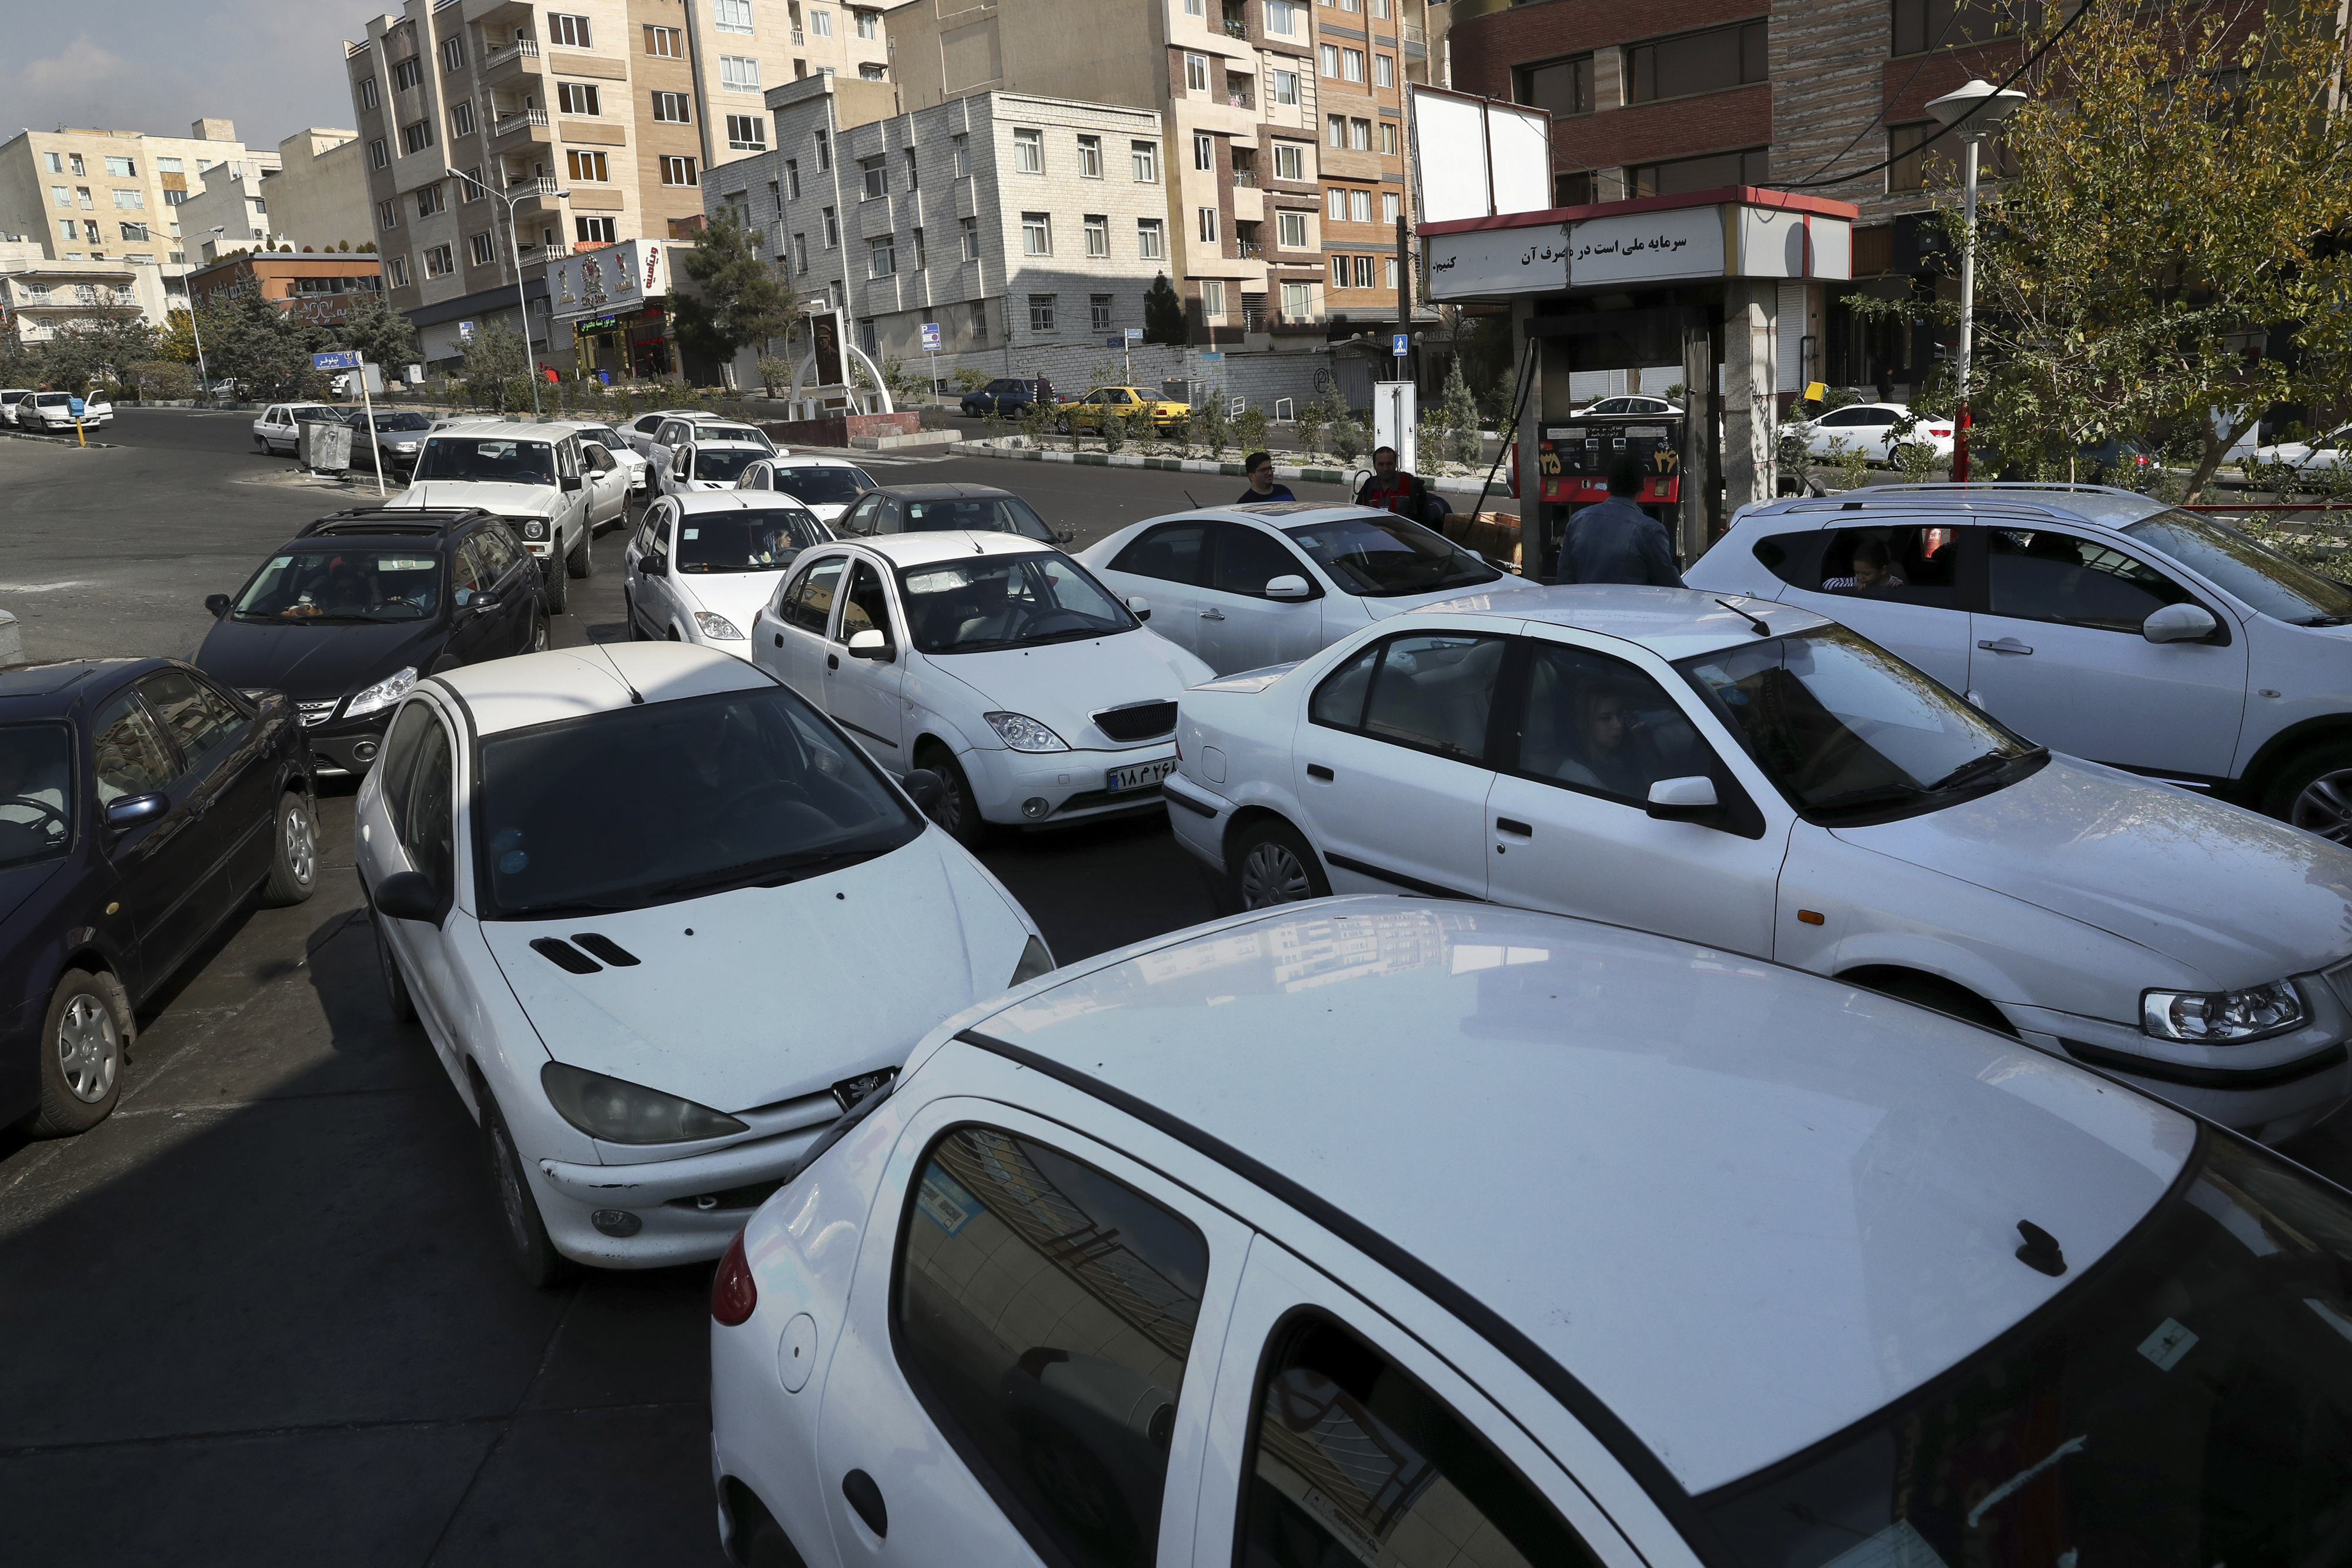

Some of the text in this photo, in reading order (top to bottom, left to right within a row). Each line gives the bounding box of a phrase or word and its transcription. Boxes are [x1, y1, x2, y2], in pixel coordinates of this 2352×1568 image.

[1594, 239, 1619, 255] است
[1622, 237, 1645, 256] ملی
[1648, 235, 1687, 252] سرمایه
[1521, 246, 1538, 265] آن
[1577, 245, 1591, 260] در
[581, 294, 608, 307] City Star
[921, 325, 928, 334] P
[319, 356, 339, 366] نیلوفر
[1539, 450, 1676, 474] ۳۵ ۳۶
